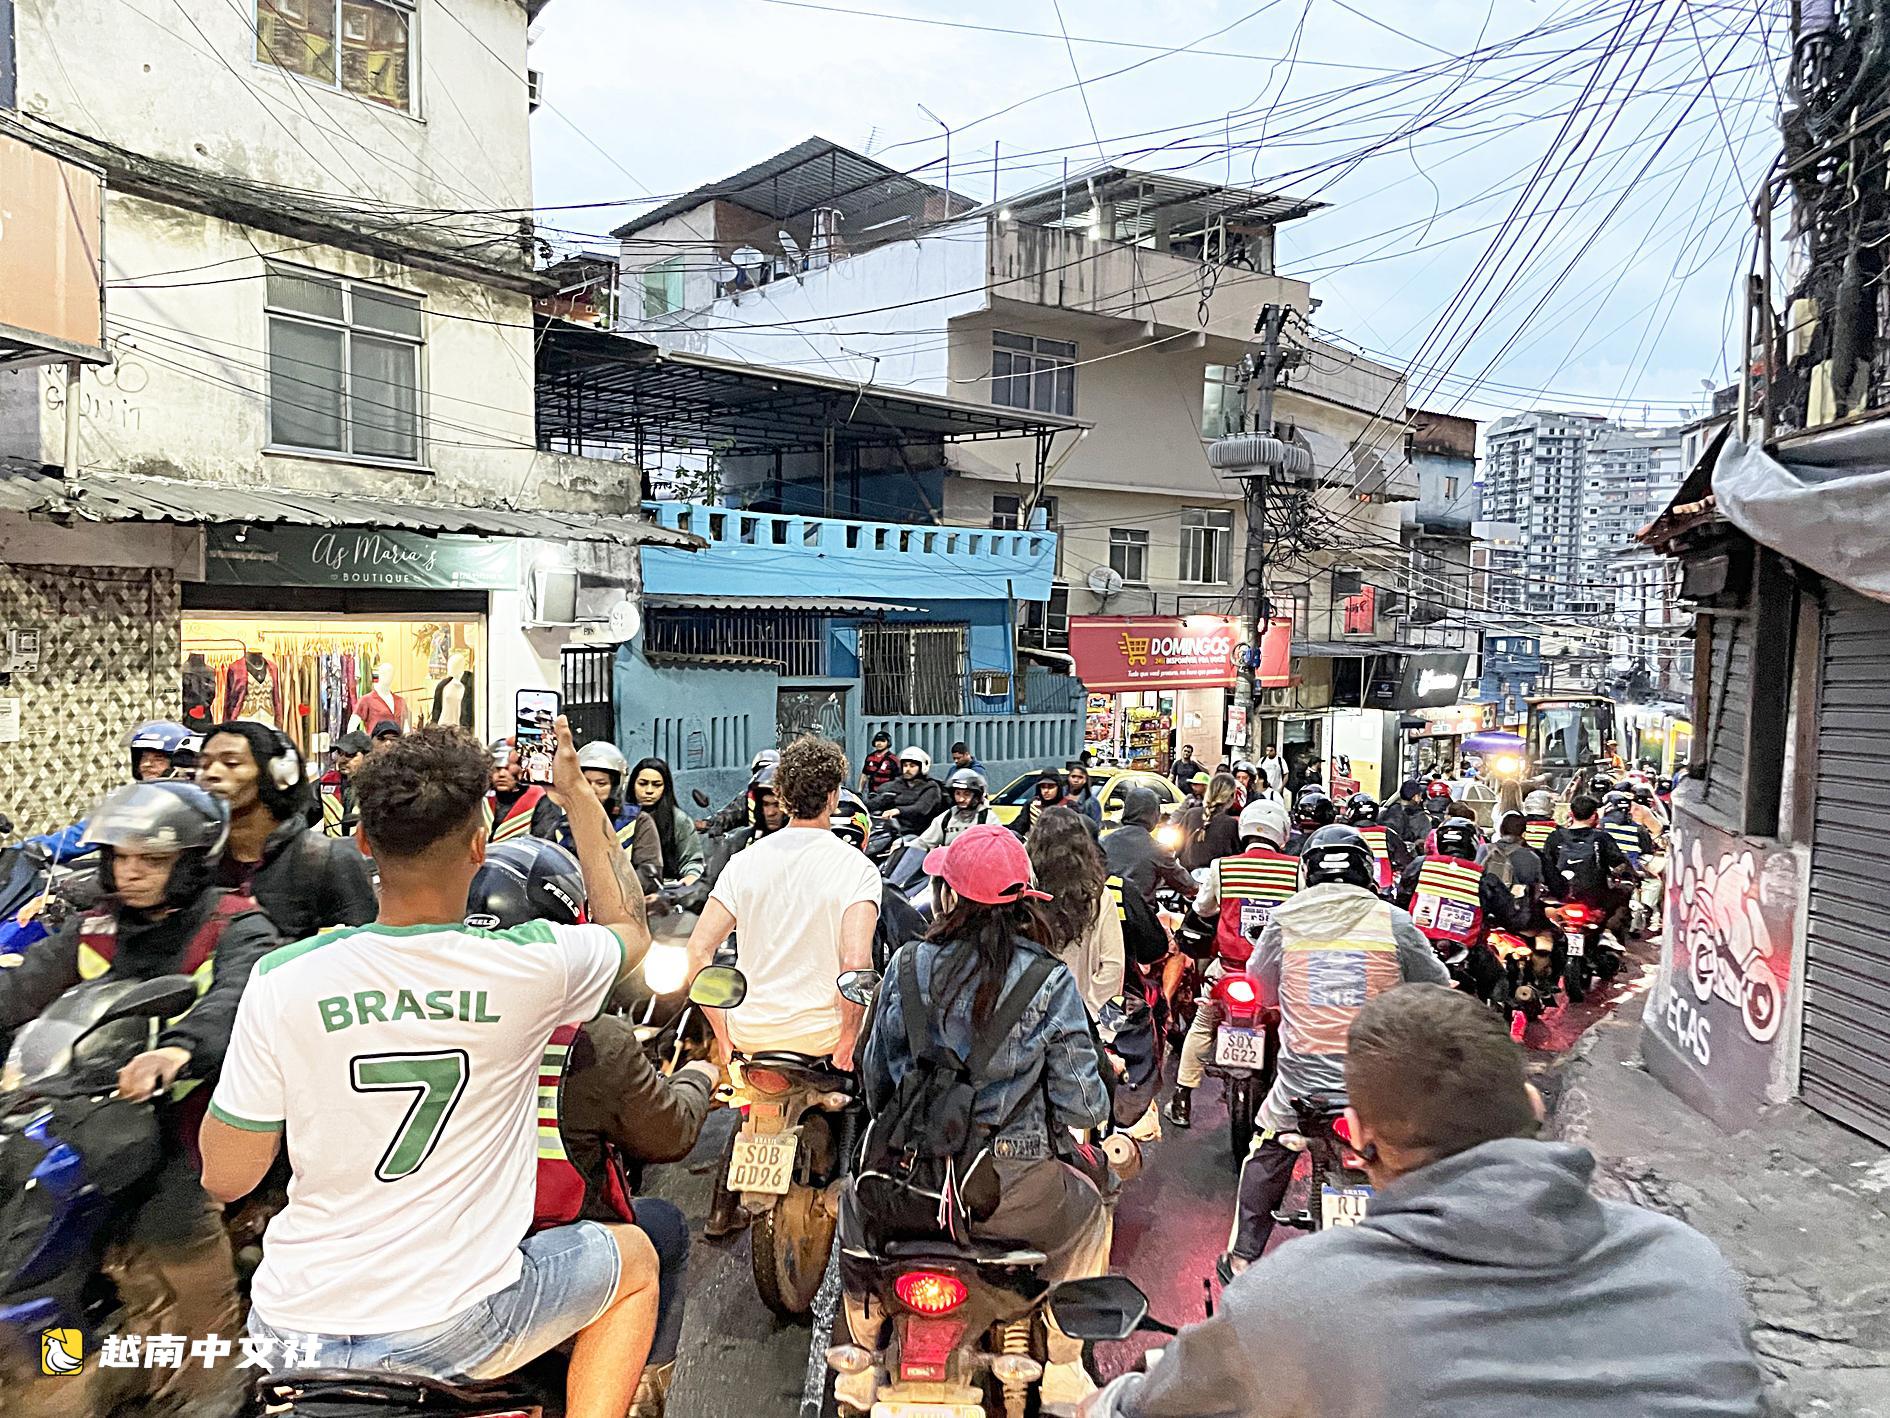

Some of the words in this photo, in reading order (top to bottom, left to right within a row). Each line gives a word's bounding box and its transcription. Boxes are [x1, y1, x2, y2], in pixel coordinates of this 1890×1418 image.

[312, 532, 349, 568] As
[354, 534, 438, 571] Maria's
[343, 572, 410, 584] BOUTIQUE
[1151, 636, 1230, 656] DOMINGOS
[543, 882, 581, 917] PEELS
[467, 918, 497, 926] PEELS
[318, 989, 502, 1033] BRASIL
[1227, 1034, 1253, 1050] SQX
[1222, 1047, 1257, 1064] 6G22
[350, 1048, 470, 1183] 7
[745, 1145, 780, 1166] SOB
[1338, 1196, 1361, 1216] RI
